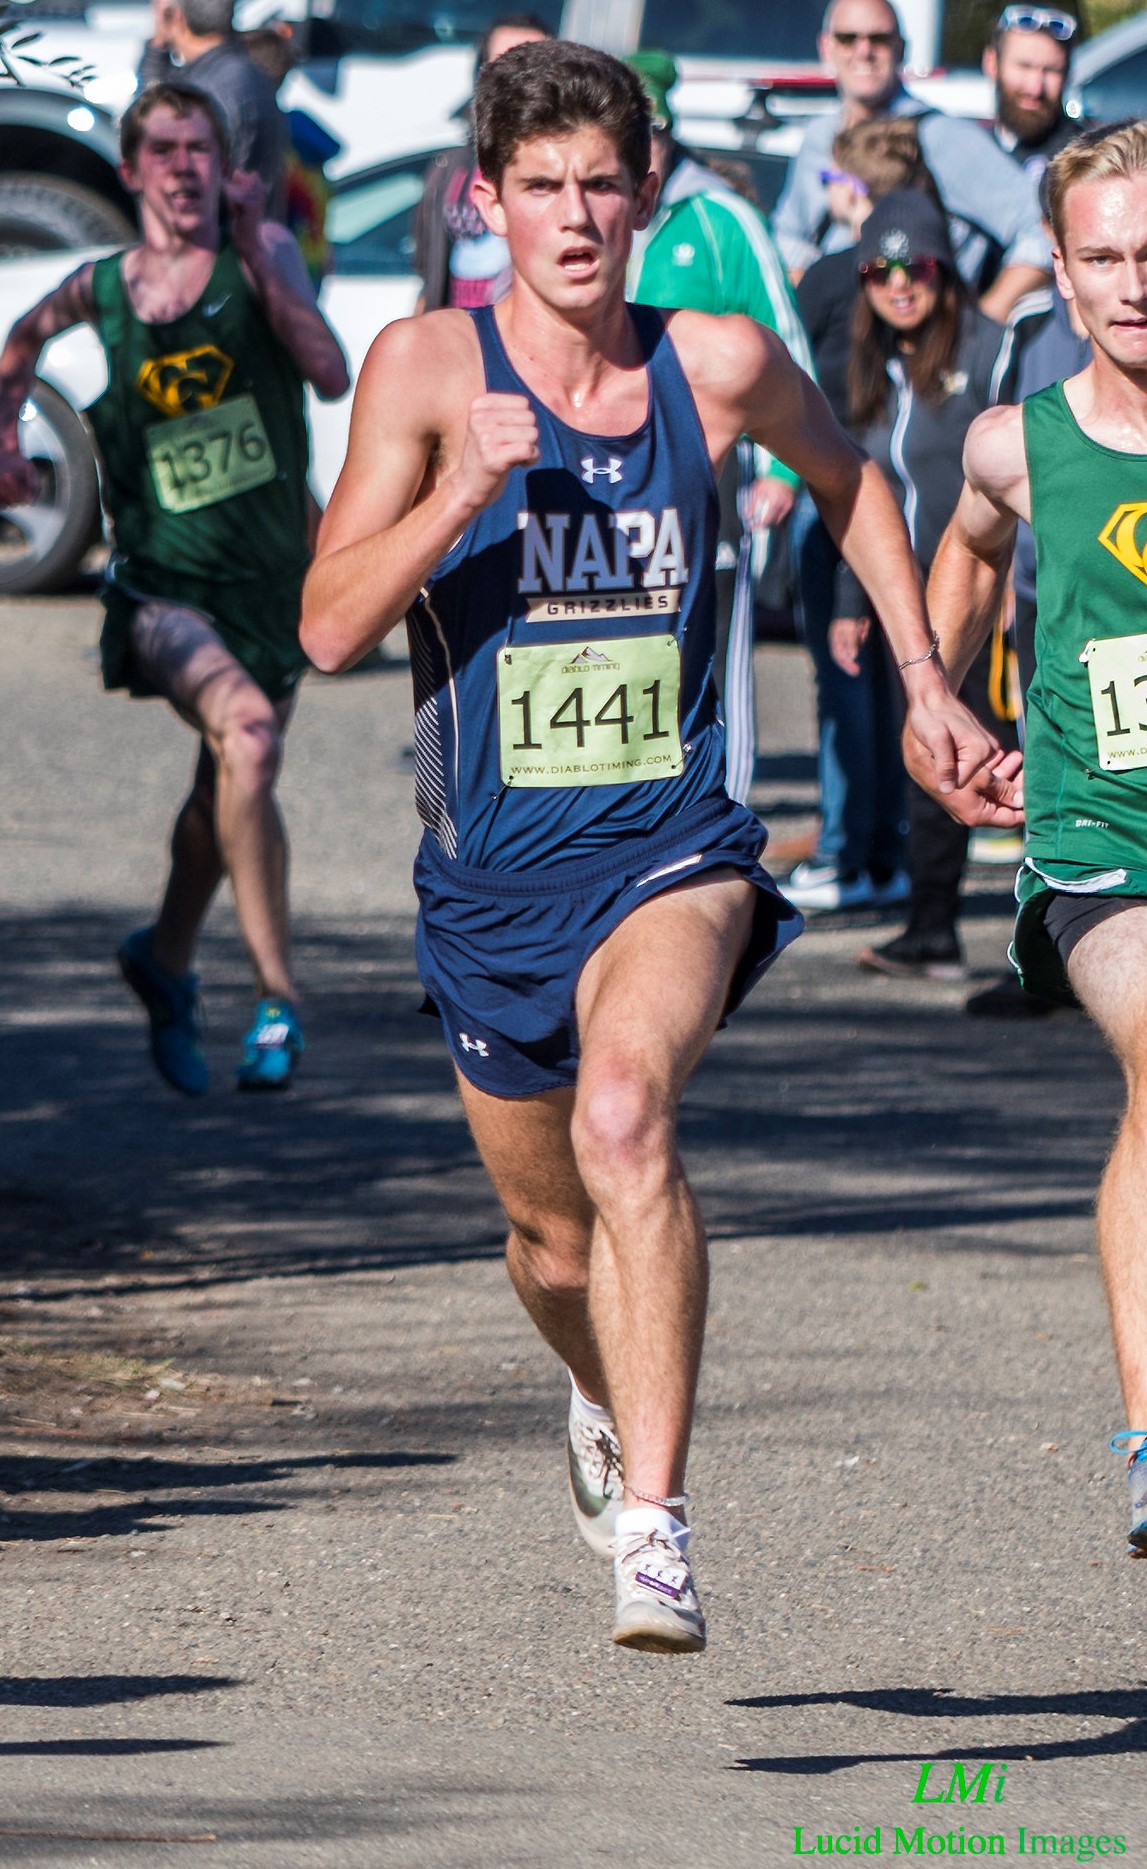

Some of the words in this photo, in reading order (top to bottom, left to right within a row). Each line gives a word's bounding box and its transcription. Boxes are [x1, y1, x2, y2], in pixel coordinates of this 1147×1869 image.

[162, 420, 267, 490] 1376
[517, 508, 689, 594] NAPA
[547, 595, 669, 616] GRIZZLIES
[511, 679, 670, 750] 1441
[511, 754, 672, 775] WWW.DIABLOTIMING.COM
[1075, 819, 1109, 829] DRI-FIT
